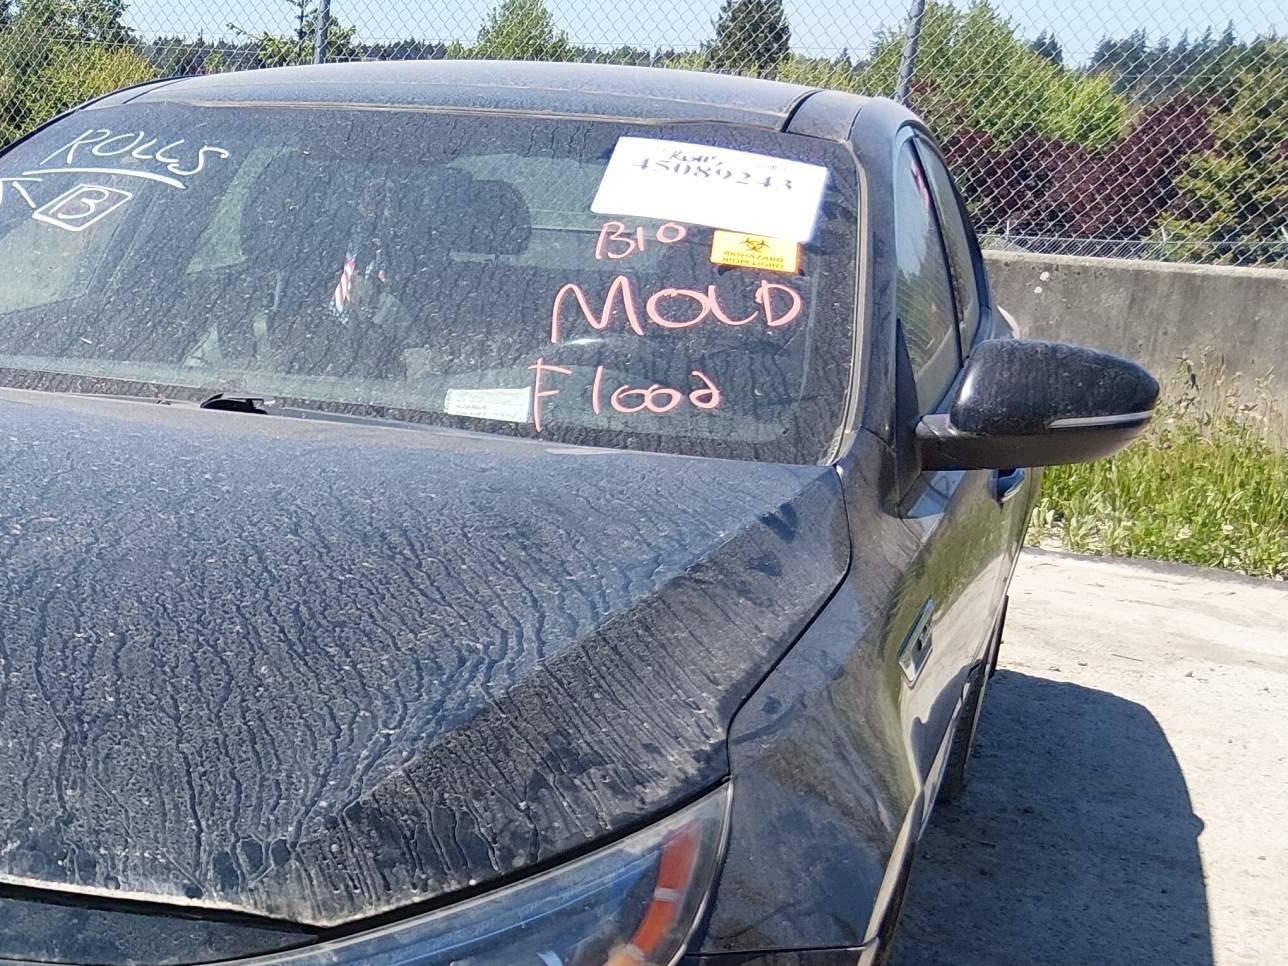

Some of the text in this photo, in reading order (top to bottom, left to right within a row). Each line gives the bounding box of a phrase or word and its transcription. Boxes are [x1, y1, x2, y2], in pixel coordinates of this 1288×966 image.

[40, 129, 230, 176] ROLLS
[48, 186, 110, 219] B
[595, 221, 687, 260] BIO
[550, 275, 802, 344] MOLD
